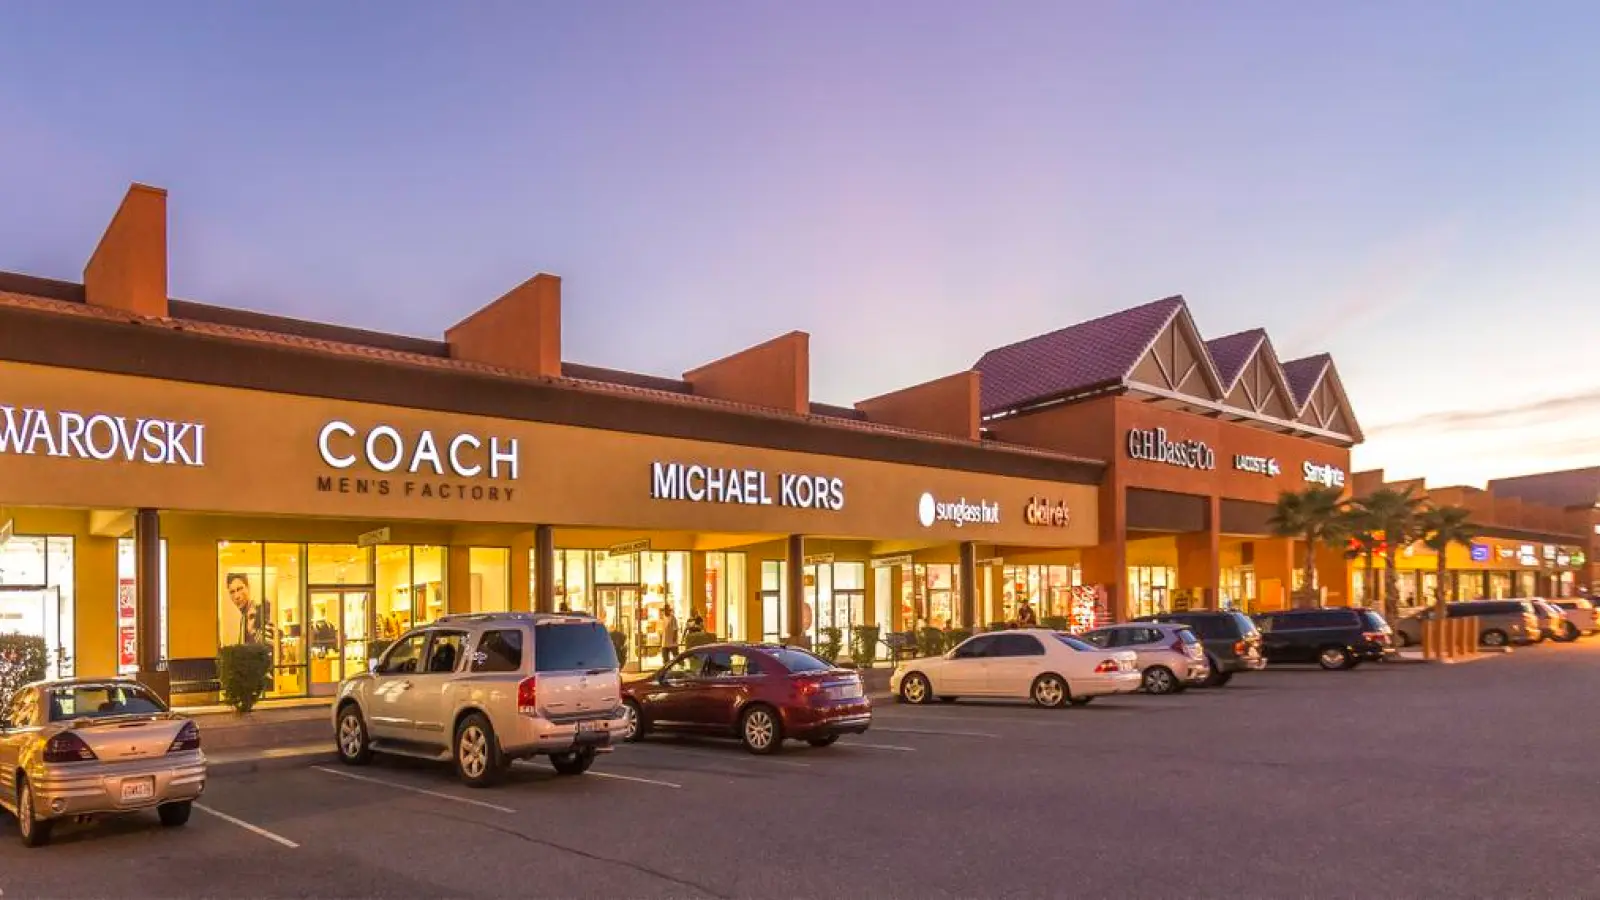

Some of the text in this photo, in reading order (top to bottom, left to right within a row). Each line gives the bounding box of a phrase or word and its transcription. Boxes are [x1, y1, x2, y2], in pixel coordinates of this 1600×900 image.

[318, 420, 518, 480] COACH
[317, 476, 515, 501] MEN'S FACTORY
[652, 462, 845, 511] MICHAEL KORS
[936, 497, 1000, 527] sunglass hut
